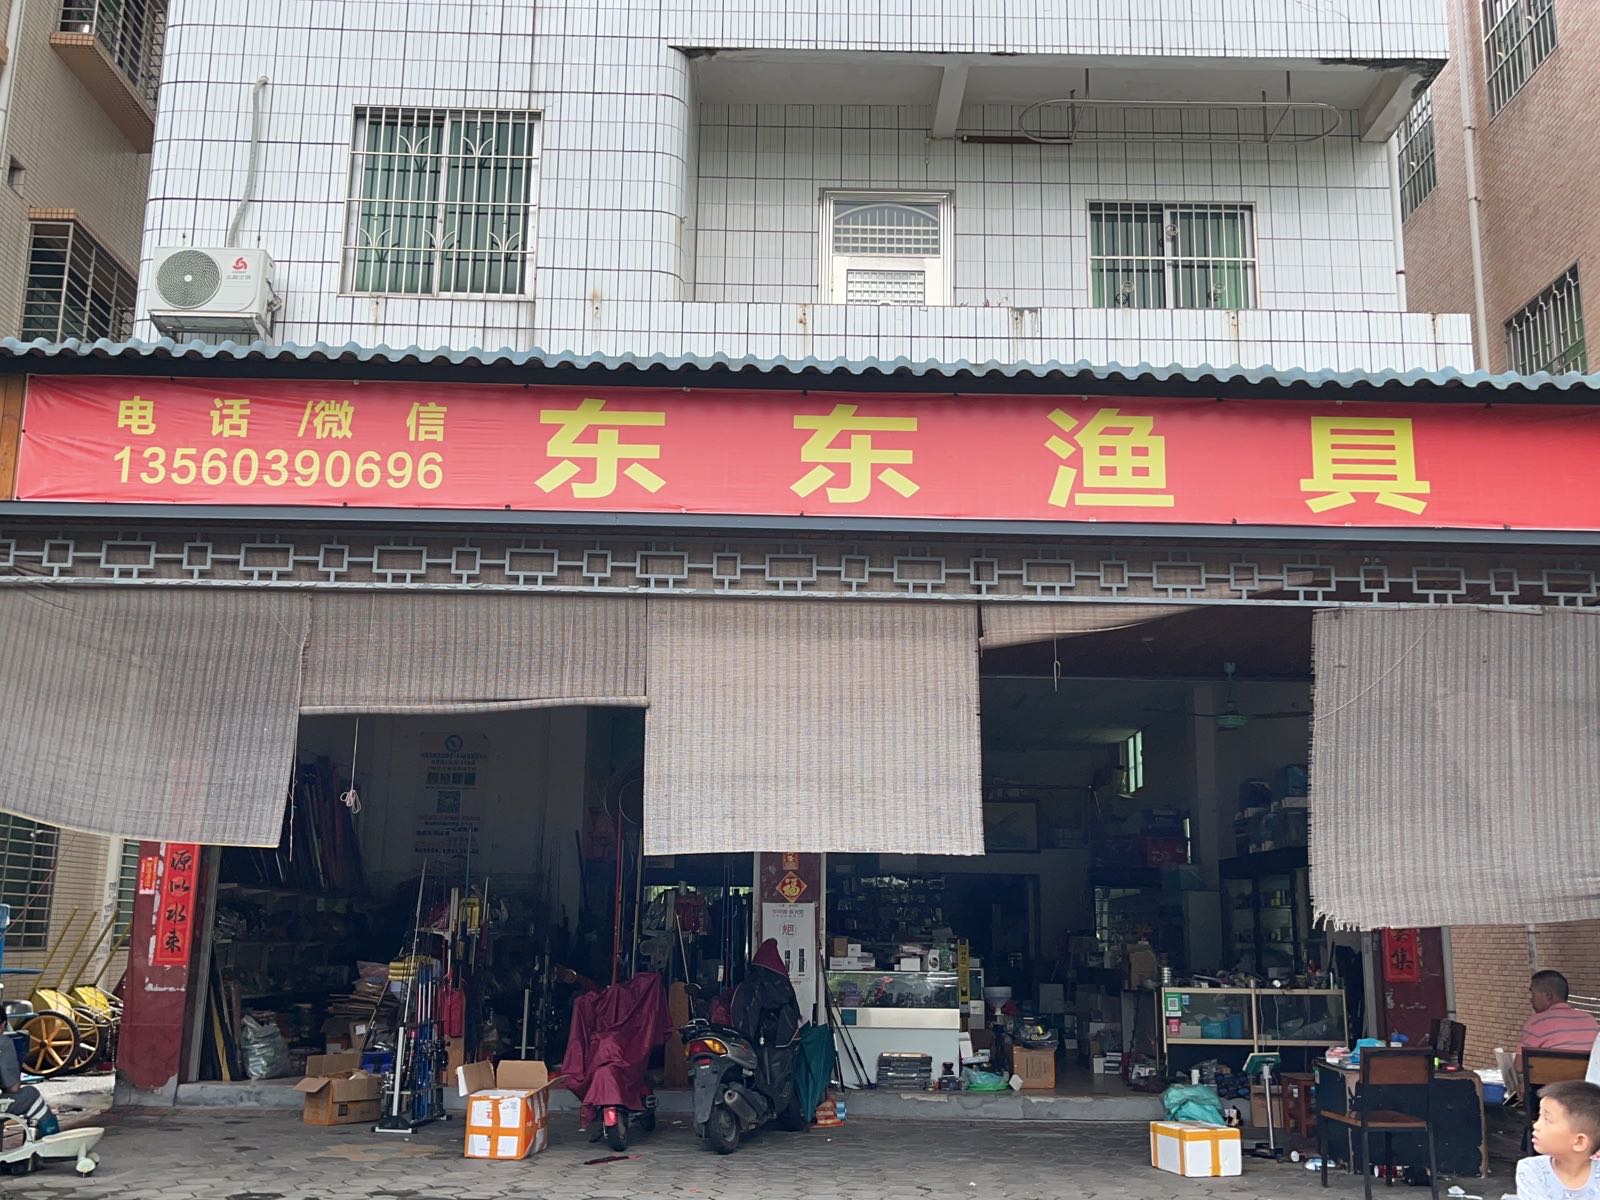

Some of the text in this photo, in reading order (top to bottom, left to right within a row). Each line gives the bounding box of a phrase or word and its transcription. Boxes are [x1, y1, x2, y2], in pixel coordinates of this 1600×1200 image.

[117, 396, 446, 441] 电话/微信
[113, 446, 444, 490] 13560390696
[536, 398, 1431, 514] 东东渔具
